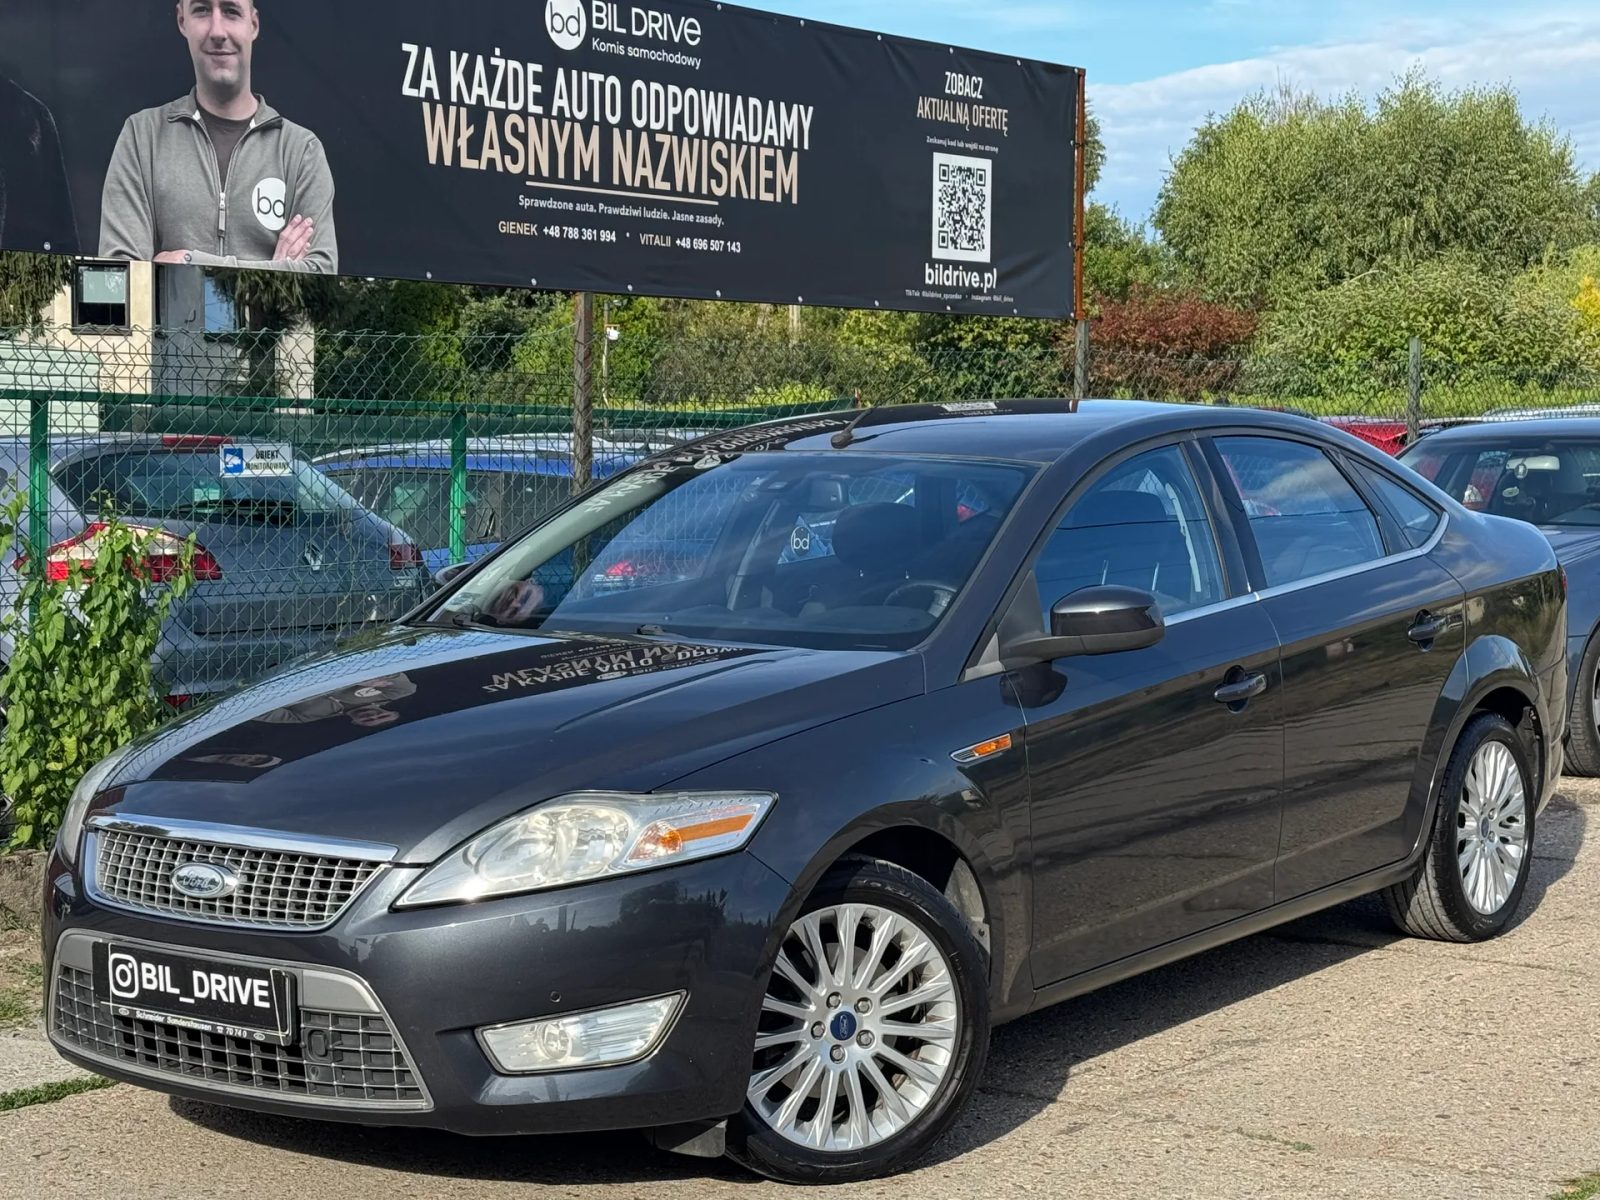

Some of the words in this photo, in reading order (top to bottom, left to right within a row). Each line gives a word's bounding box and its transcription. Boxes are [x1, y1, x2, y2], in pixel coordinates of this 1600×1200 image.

[592, 0, 627, 34] BIL
[592, 37, 625, 55] Komis
[627, 46, 701, 70] samochodowy
[401, 43, 440, 100] ZA
[449, 47, 543, 115] KAŻDE
[551, 67, 622, 125] AUTO
[631, 79, 814, 150] ODPOWIADAMY
[944, 71, 983, 99] ZOBACZ
[917, 96, 970, 131] AKTUALNĄ
[972, 105, 1008, 137] OFERTĘ
[422, 102, 600, 183] WŁASNYM
[612, 128, 799, 204] NAZWISKIEM
[518, 194, 574, 211] Sprawdzone
[575, 203, 597, 213] auta.
[598, 202, 642, 218] Prawdziwi
[643, 206, 671, 220] ludzie.
[671, 211, 694, 223] Jasne
[695, 214, 725, 228] zasady.
[498, 221, 538, 236] GIENEK
[543, 225, 560, 238] +48
[562, 226, 579, 239] 788
[581, 228, 597, 241] 361
[600, 230, 616, 242] 994
[639, 233, 671, 247] VITALII
[675, 237, 691, 249] +48
[693, 238, 708, 250] 696
[710, 240, 724, 251] 507
[726, 241, 741, 253] 143
[924, 262, 998, 294] bildrive.pl
[255, 449, 279, 460] OBIEKT
[141, 962, 270, 1009] BIL_DRIVE
